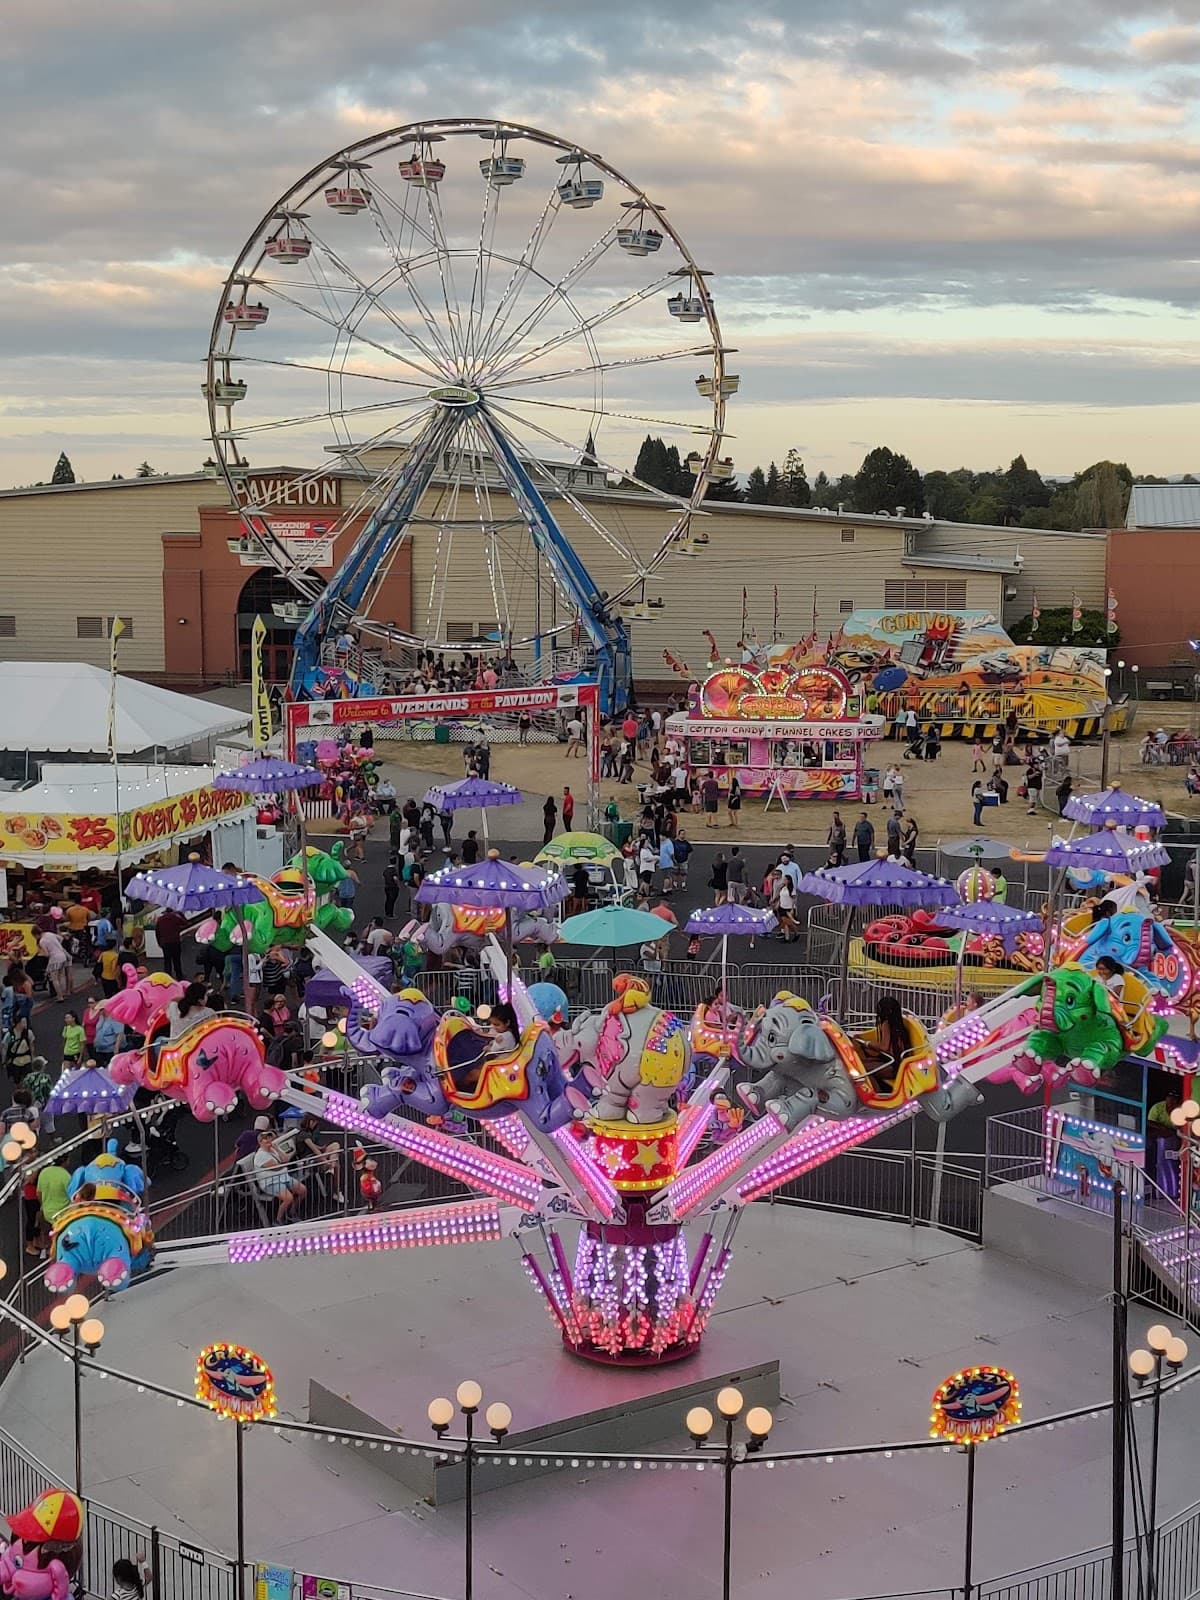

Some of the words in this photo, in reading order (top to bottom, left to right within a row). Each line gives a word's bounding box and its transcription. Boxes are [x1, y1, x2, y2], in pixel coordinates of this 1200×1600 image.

[235, 479, 337, 505] PAVILION
[339, 705, 379, 718] Welcome
[391, 698, 469, 714] WEEKENDS
[494, 692, 553, 707] PAVILION
[689, 726, 728, 734] COTTON
[732, 726, 765, 736] CANDY
[775, 727, 814, 736] FUNNEL
[818, 728, 853, 737] CAKES
